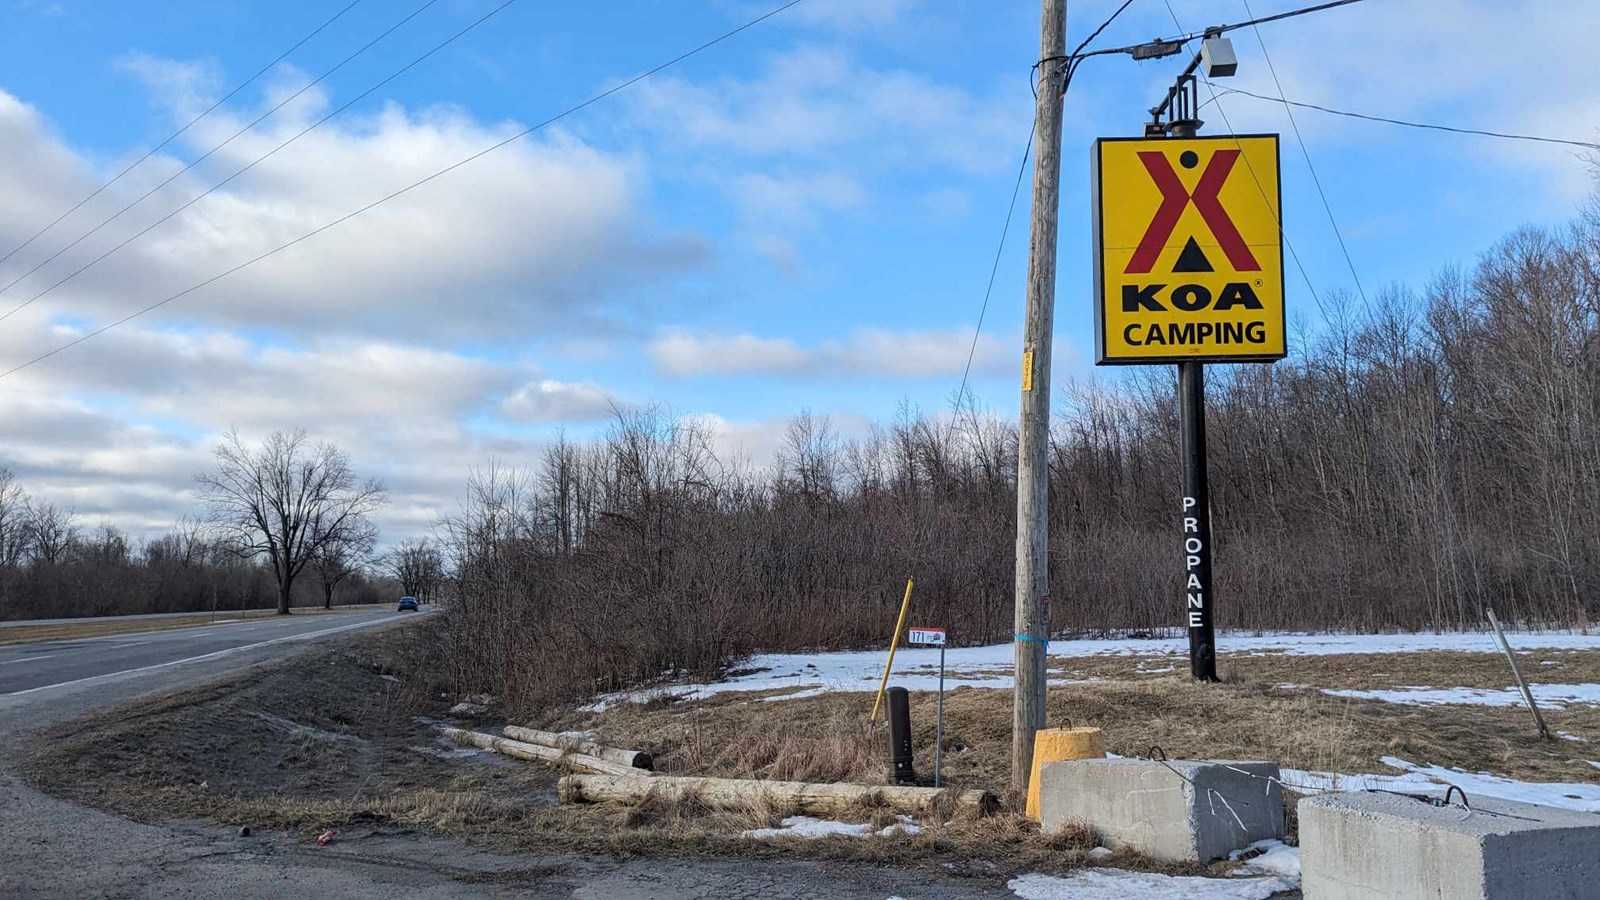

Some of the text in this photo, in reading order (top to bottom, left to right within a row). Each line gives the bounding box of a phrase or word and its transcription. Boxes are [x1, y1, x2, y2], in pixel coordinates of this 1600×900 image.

[1121, 282, 1264, 312] KOA
[1123, 321, 1266, 346] CAMPING
[1183, 497, 1203, 627] PROPANE
[912, 631, 925, 643] 171
